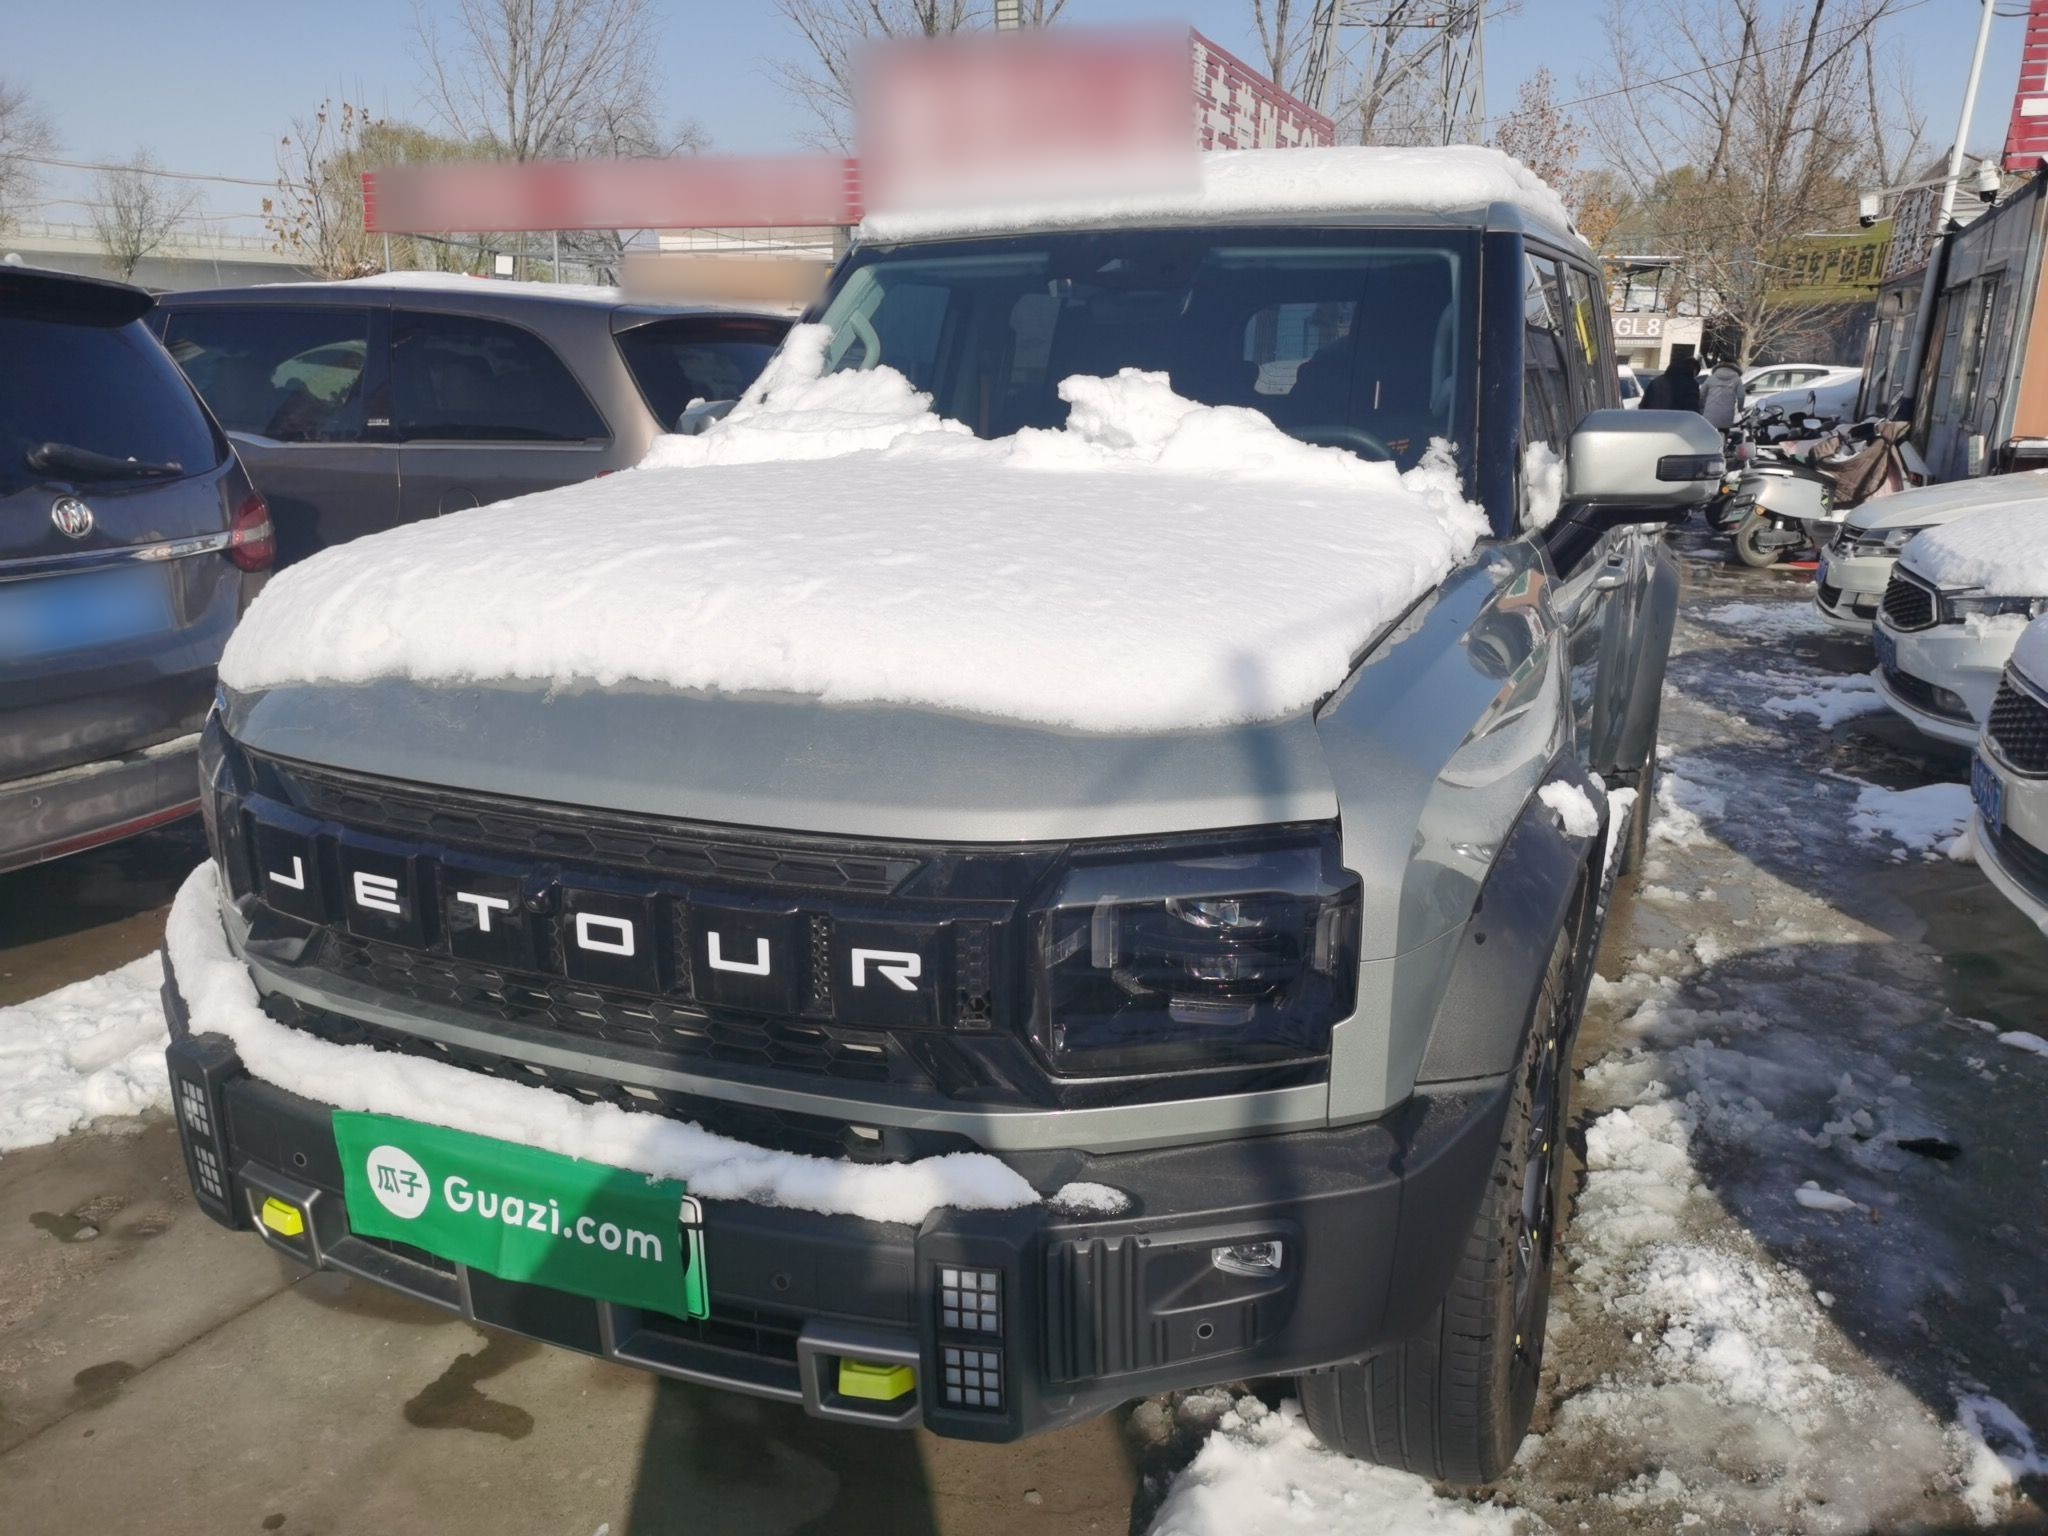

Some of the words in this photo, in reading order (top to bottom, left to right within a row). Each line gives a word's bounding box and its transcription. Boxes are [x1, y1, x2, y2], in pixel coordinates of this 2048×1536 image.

[269, 856, 922, 991] JETOUR
[376, 1164, 423, 1198] 瓜子
[443, 1175, 663, 1262] Guazi.com
